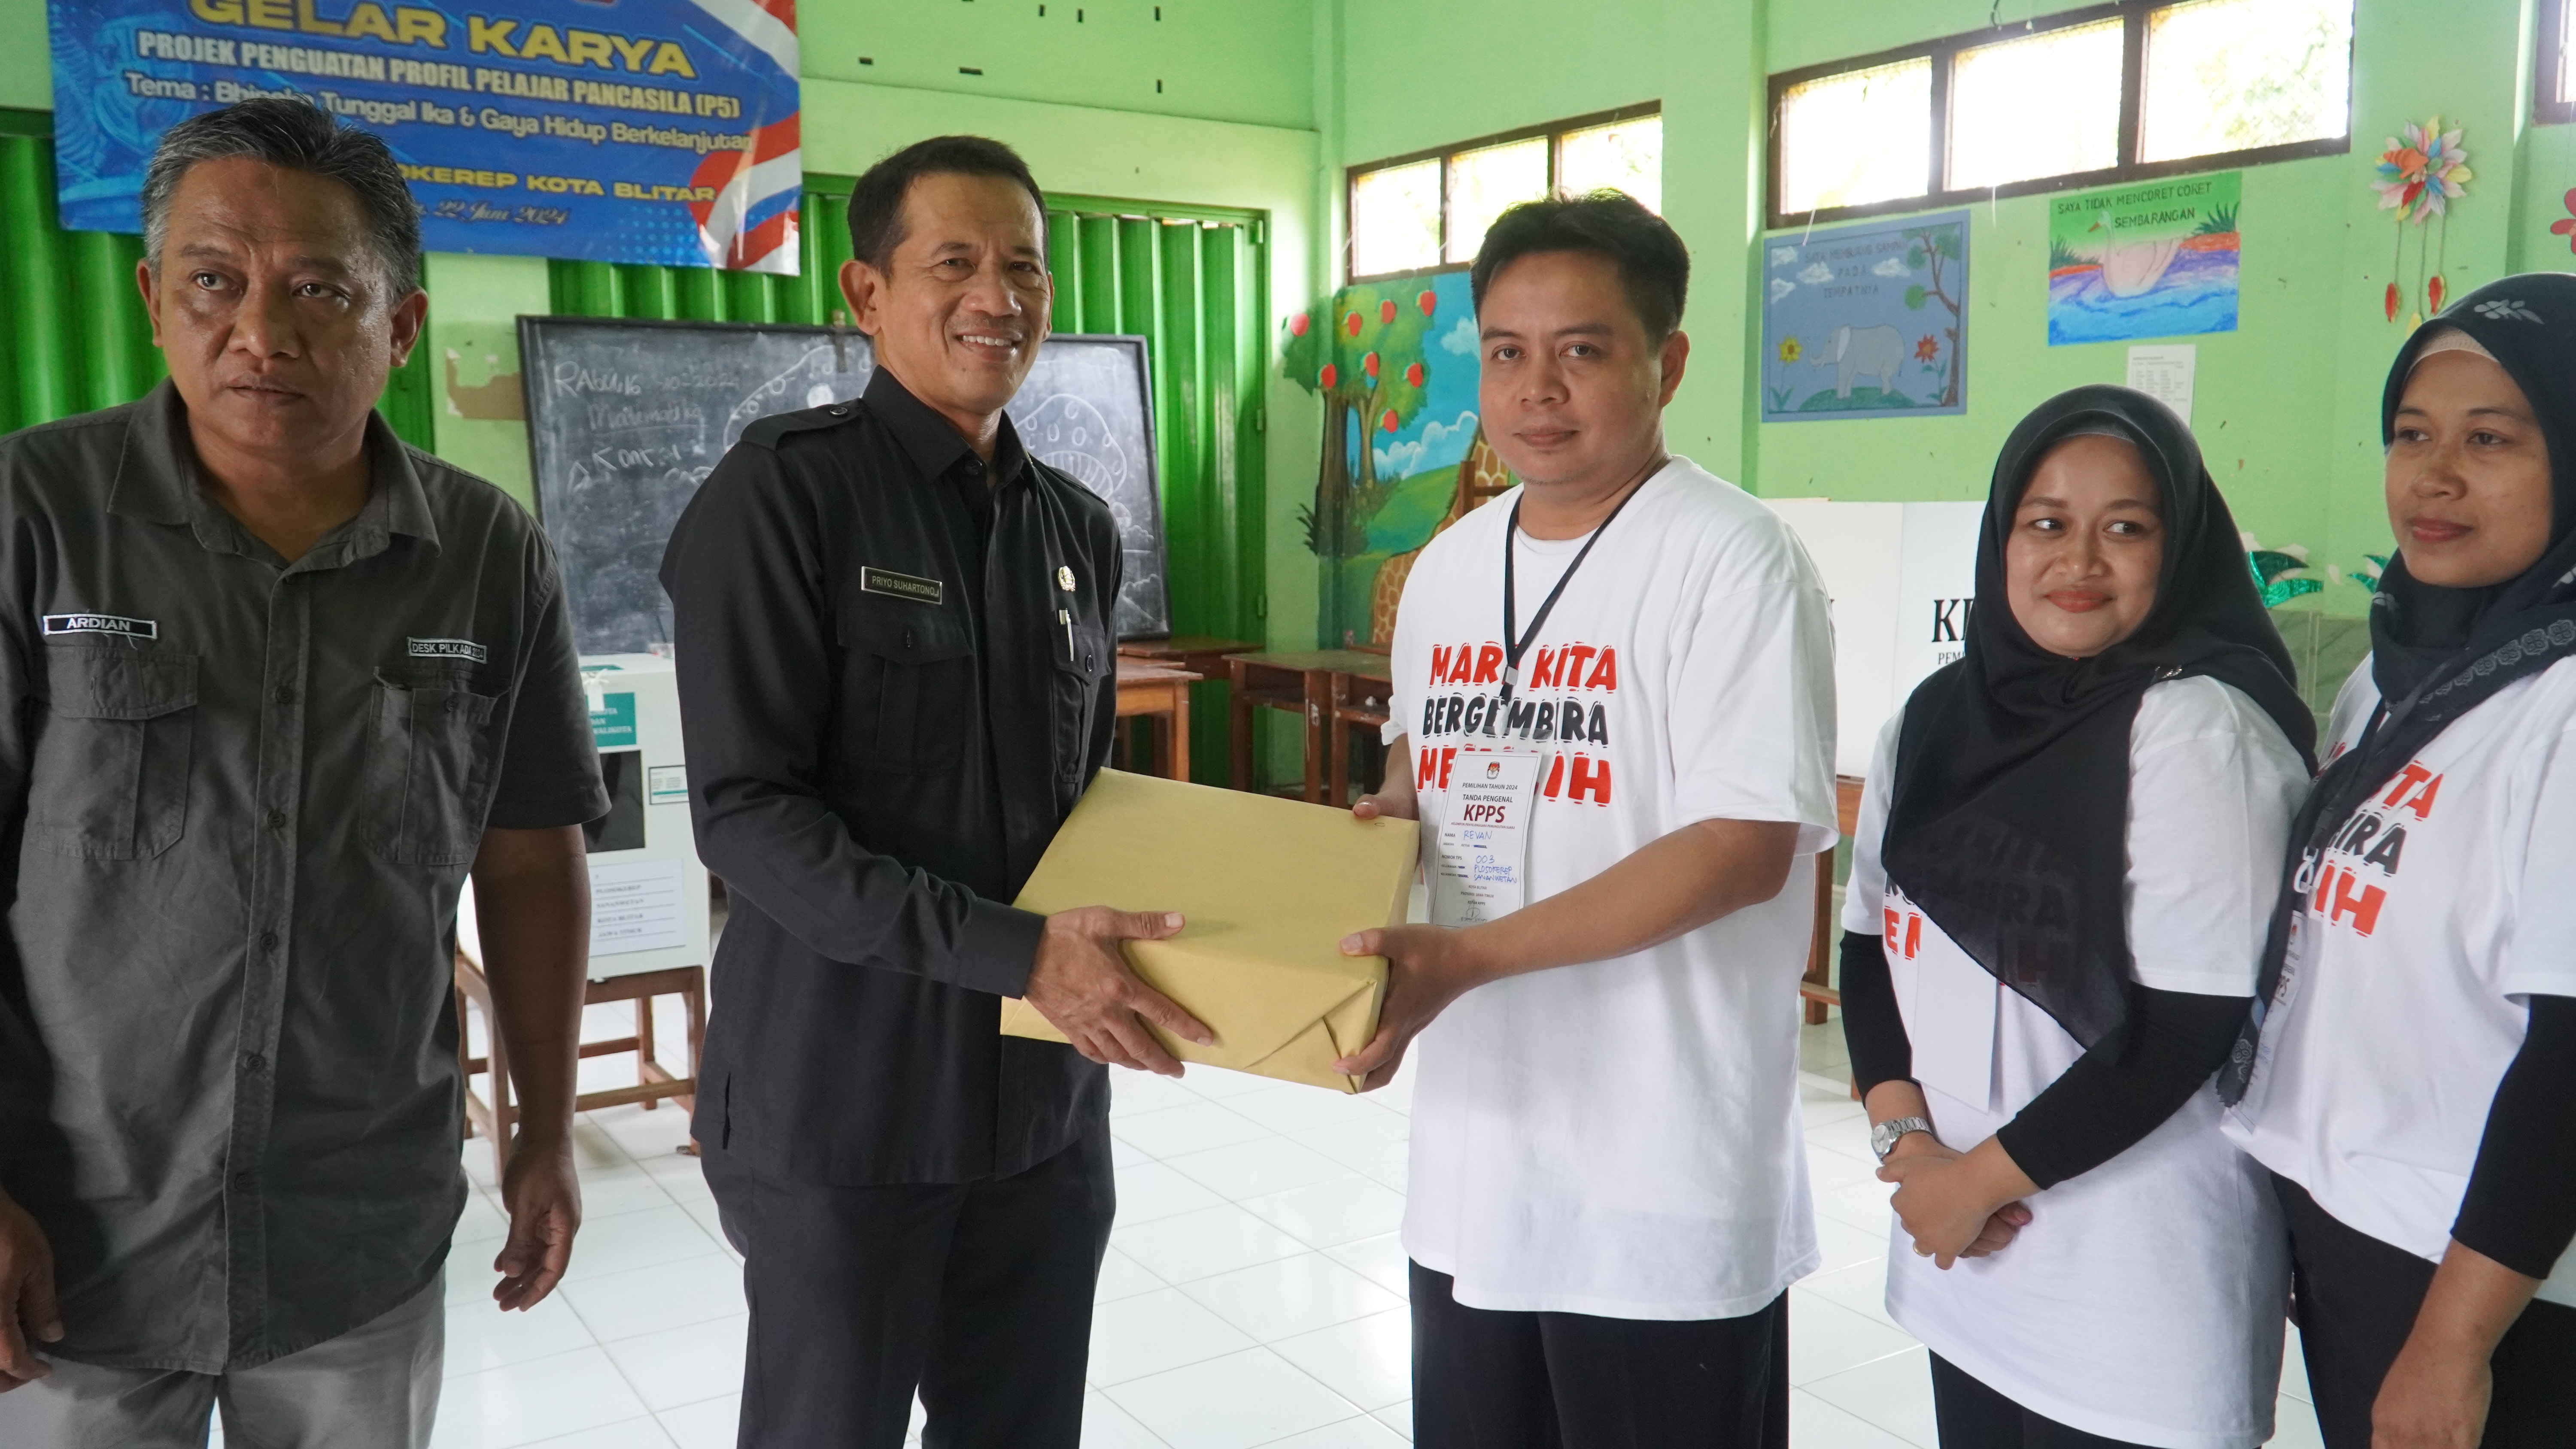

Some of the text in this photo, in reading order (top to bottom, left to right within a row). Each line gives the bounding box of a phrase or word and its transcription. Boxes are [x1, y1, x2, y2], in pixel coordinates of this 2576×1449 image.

[190, 0, 696, 78] GELAR KARYA
[138, 30, 741, 119] PROJEK PENGUATAN PROFIL PELAJAR PANCASILA (P5)
[125, 72, 196, 100] Tema
[321, 91, 416, 124] Tunggal
[422, 102, 455, 125] Ika
[459, 106, 476, 127] &
[480, 109, 539, 138] Gaya
[544, 116, 607, 144] Hidup
[612, 123, 753, 154] Berkelanjutan
[526, 175, 605, 197] KOTA
[614, 183, 717, 202] BLITAR
[2058, 201, 2081, 214] SAYA
[2086, 196, 2112, 210] TIDAK
[2116, 186, 2174, 206] MENCORET
[462, 201, 510, 221] Juni
[2114, 207, 2196, 228] SEMBARANGAN
[872, 575, 893, 588] PRIYO
[67, 617, 130, 631] ARDIAN
[412, 643, 437, 653] DESK
[439, 643, 471, 655] PILKADA
[1429, 645, 1617, 691] MAR KITA
[1417, 747, 1612, 804] MEIH
[1464, 804, 1506, 823] KPPS
[1464, 830, 1493, 840] REVAN
[1476, 855, 1495, 864] 003
[1474, 864, 1513, 876] PLOSOKEREP
[1474, 874, 1517, 884] SANANWETAN
